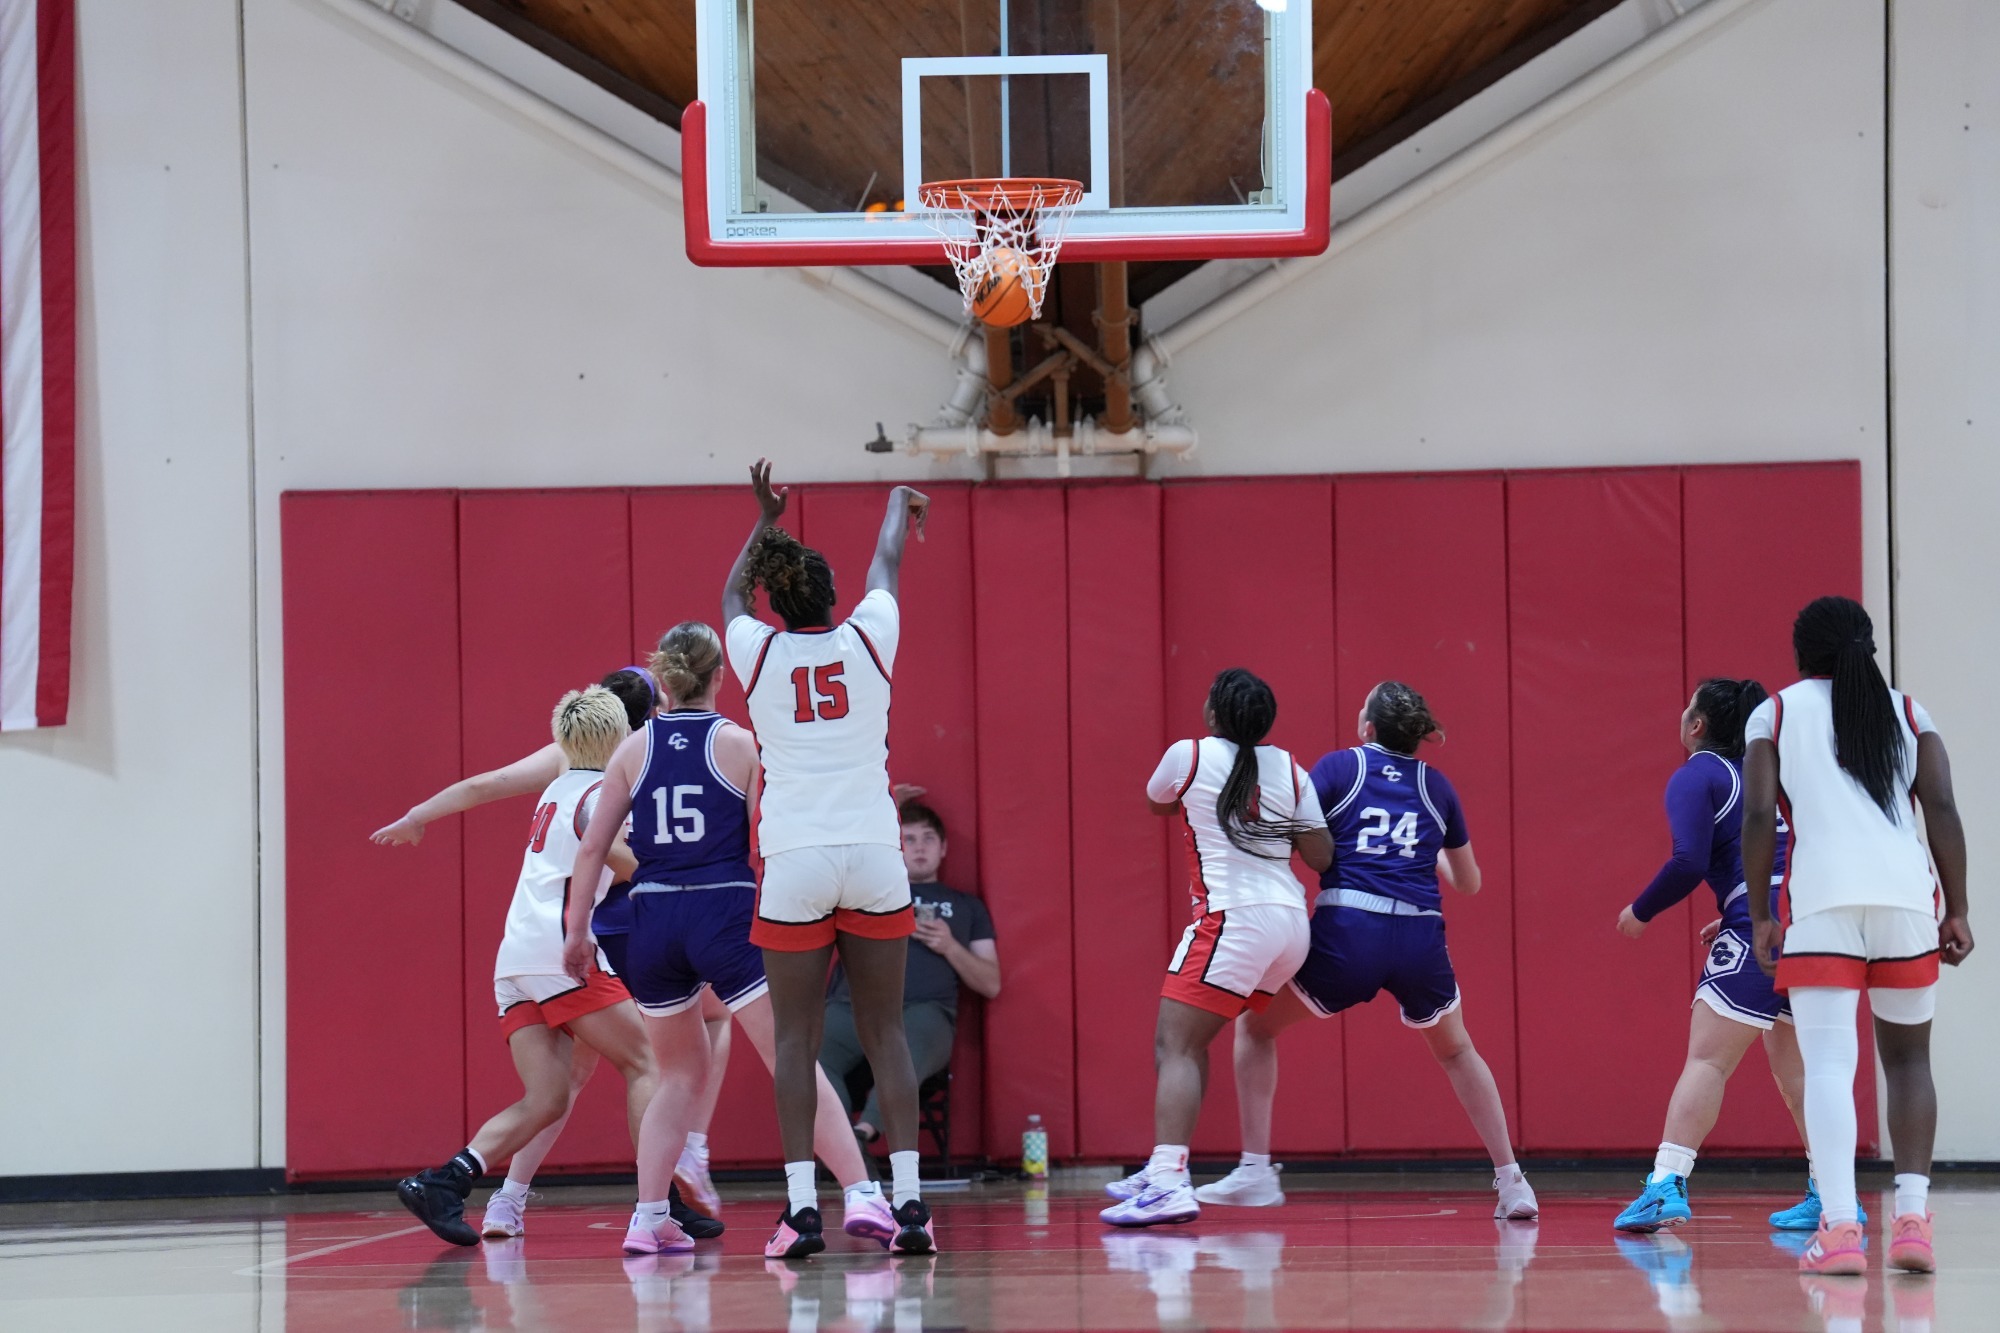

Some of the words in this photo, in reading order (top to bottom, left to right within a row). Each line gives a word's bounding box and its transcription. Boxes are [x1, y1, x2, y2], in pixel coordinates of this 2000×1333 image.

[792, 661, 849, 722] 15
[668, 733, 689, 750] CC
[1382, 765, 1402, 782] CC
[652, 785, 705, 844] 15
[1356, 807, 1419, 858] 24
[1711, 942, 1734, 965] CC
